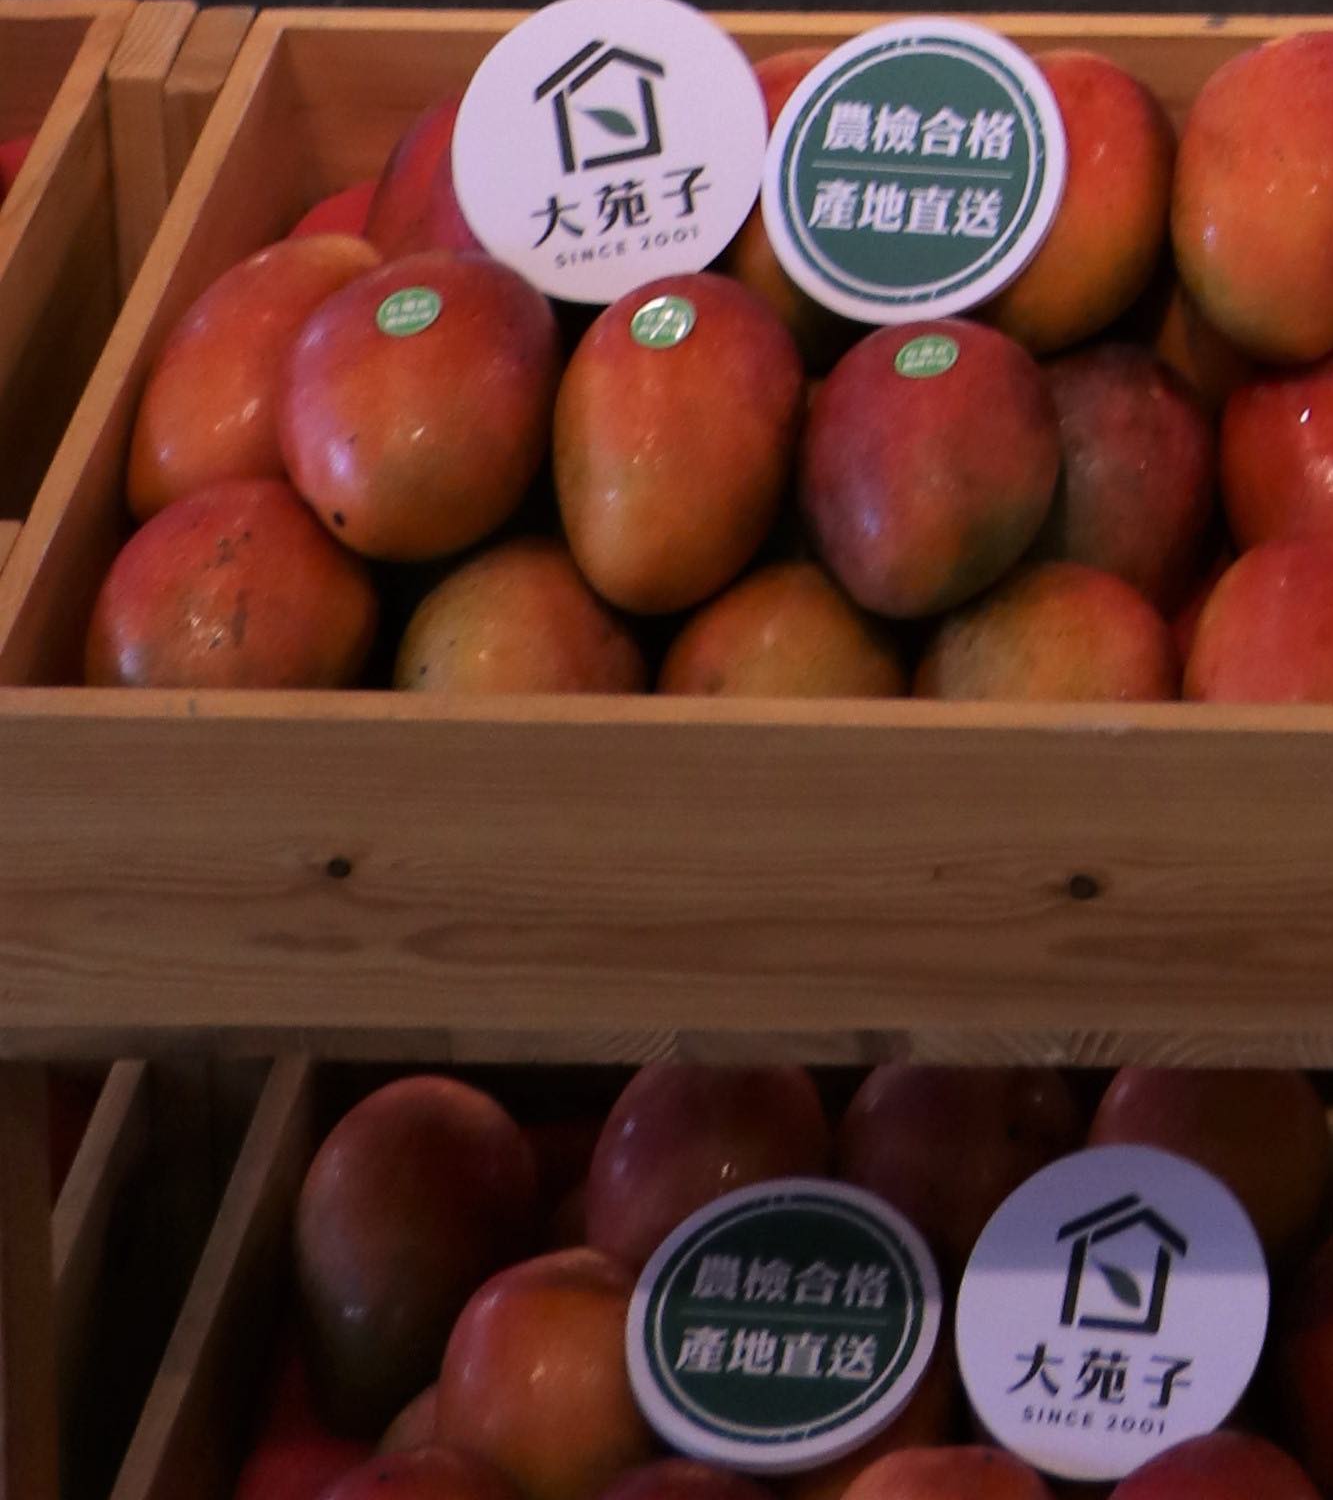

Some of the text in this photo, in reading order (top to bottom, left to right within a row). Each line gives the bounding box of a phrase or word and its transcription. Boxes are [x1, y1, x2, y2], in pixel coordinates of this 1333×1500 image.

[821, 99, 1014, 162] 農檢合格
[530, 165, 713, 250] 大苑子
[807, 179, 1003, 239] 產地直送
[554, 225, 701, 270] SINCE 2001
[690, 1255, 890, 1310] 農檢合格
[674, 1327, 879, 1382] 產地直送
[1007, 1342, 1194, 1409] 大苑子
[1023, 1406, 1167, 1435] SINCE 2001
